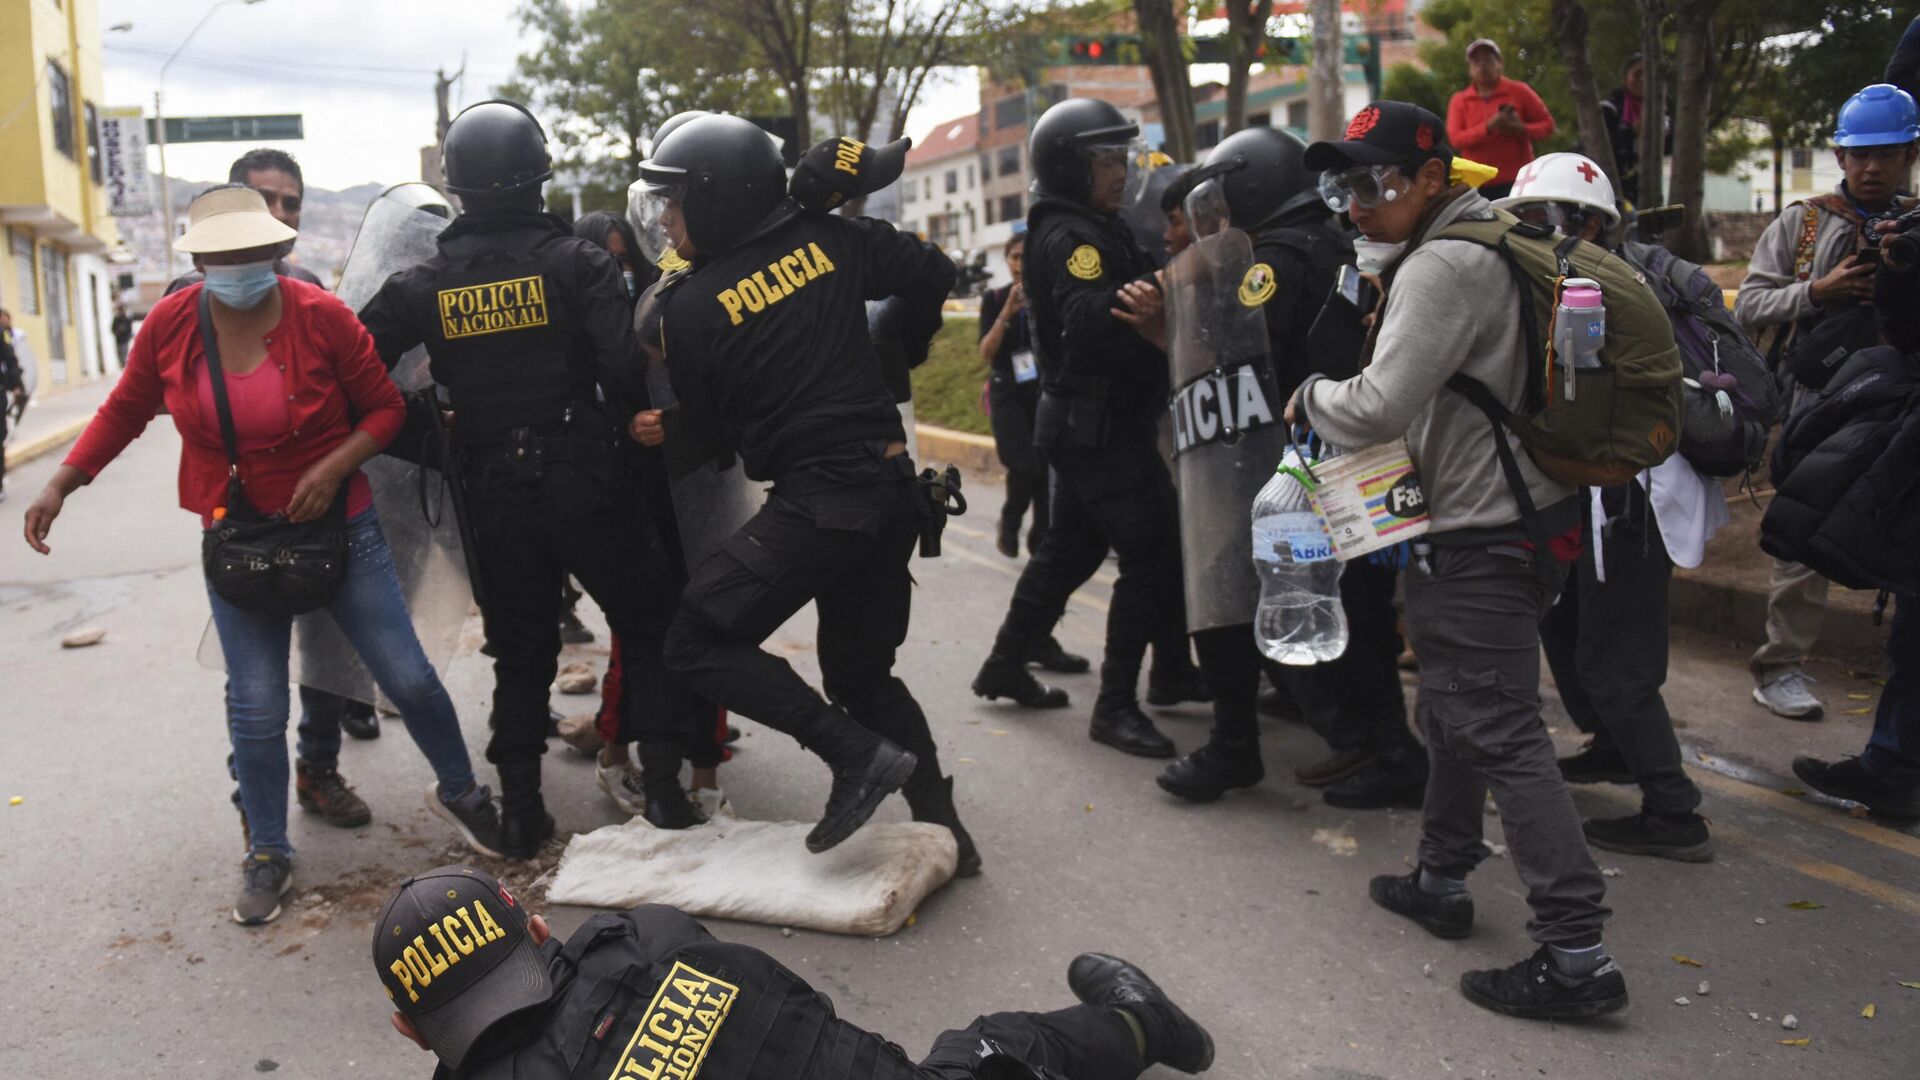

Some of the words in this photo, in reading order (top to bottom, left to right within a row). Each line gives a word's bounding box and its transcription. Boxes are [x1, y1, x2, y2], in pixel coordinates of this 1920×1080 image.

[442, 281, 542, 317] POLICIA
[446, 307, 542, 335] NACIONAL
[717, 242, 835, 326] POLICIA
[390, 900, 506, 1003] POLICIA
[618, 978, 711, 1080] LICIA
[660, 992, 728, 1080] IONAL
